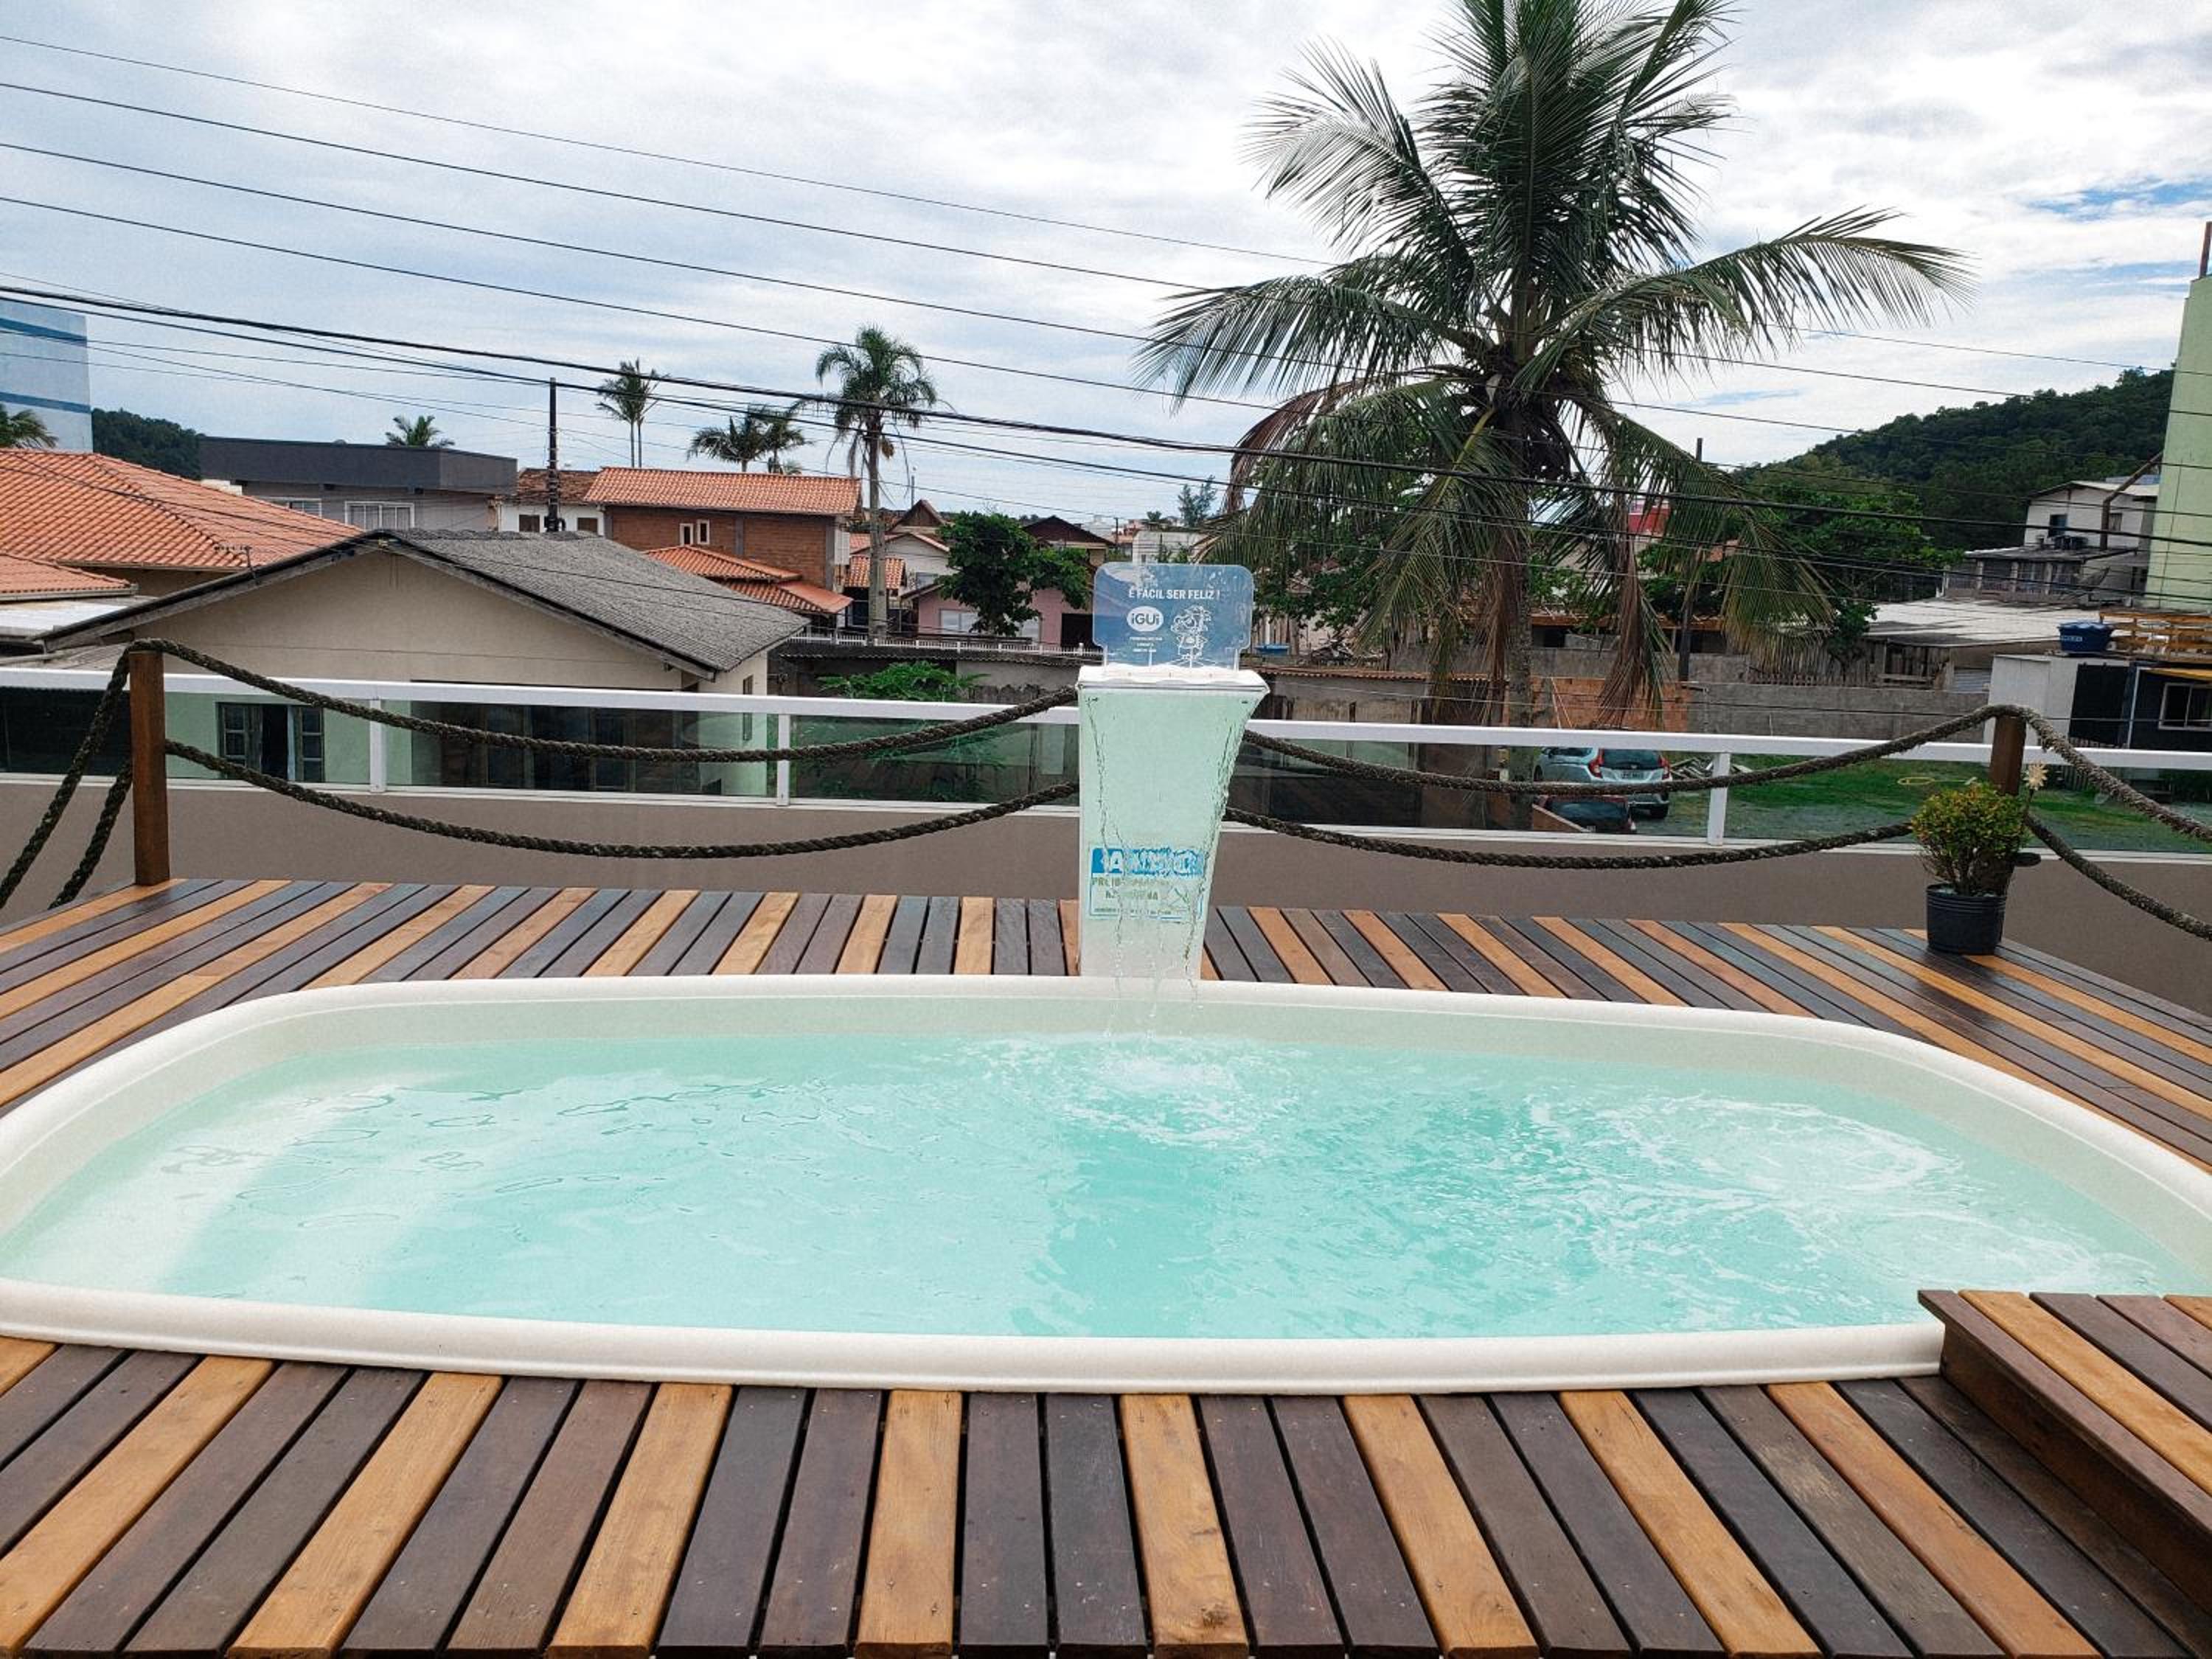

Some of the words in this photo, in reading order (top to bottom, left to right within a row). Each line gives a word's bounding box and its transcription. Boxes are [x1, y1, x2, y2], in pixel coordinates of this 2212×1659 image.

[1166, 589, 1186, 599] SER
[1188, 589, 1214, 599] FELIZ
[1132, 613, 1160, 625] iGUi
